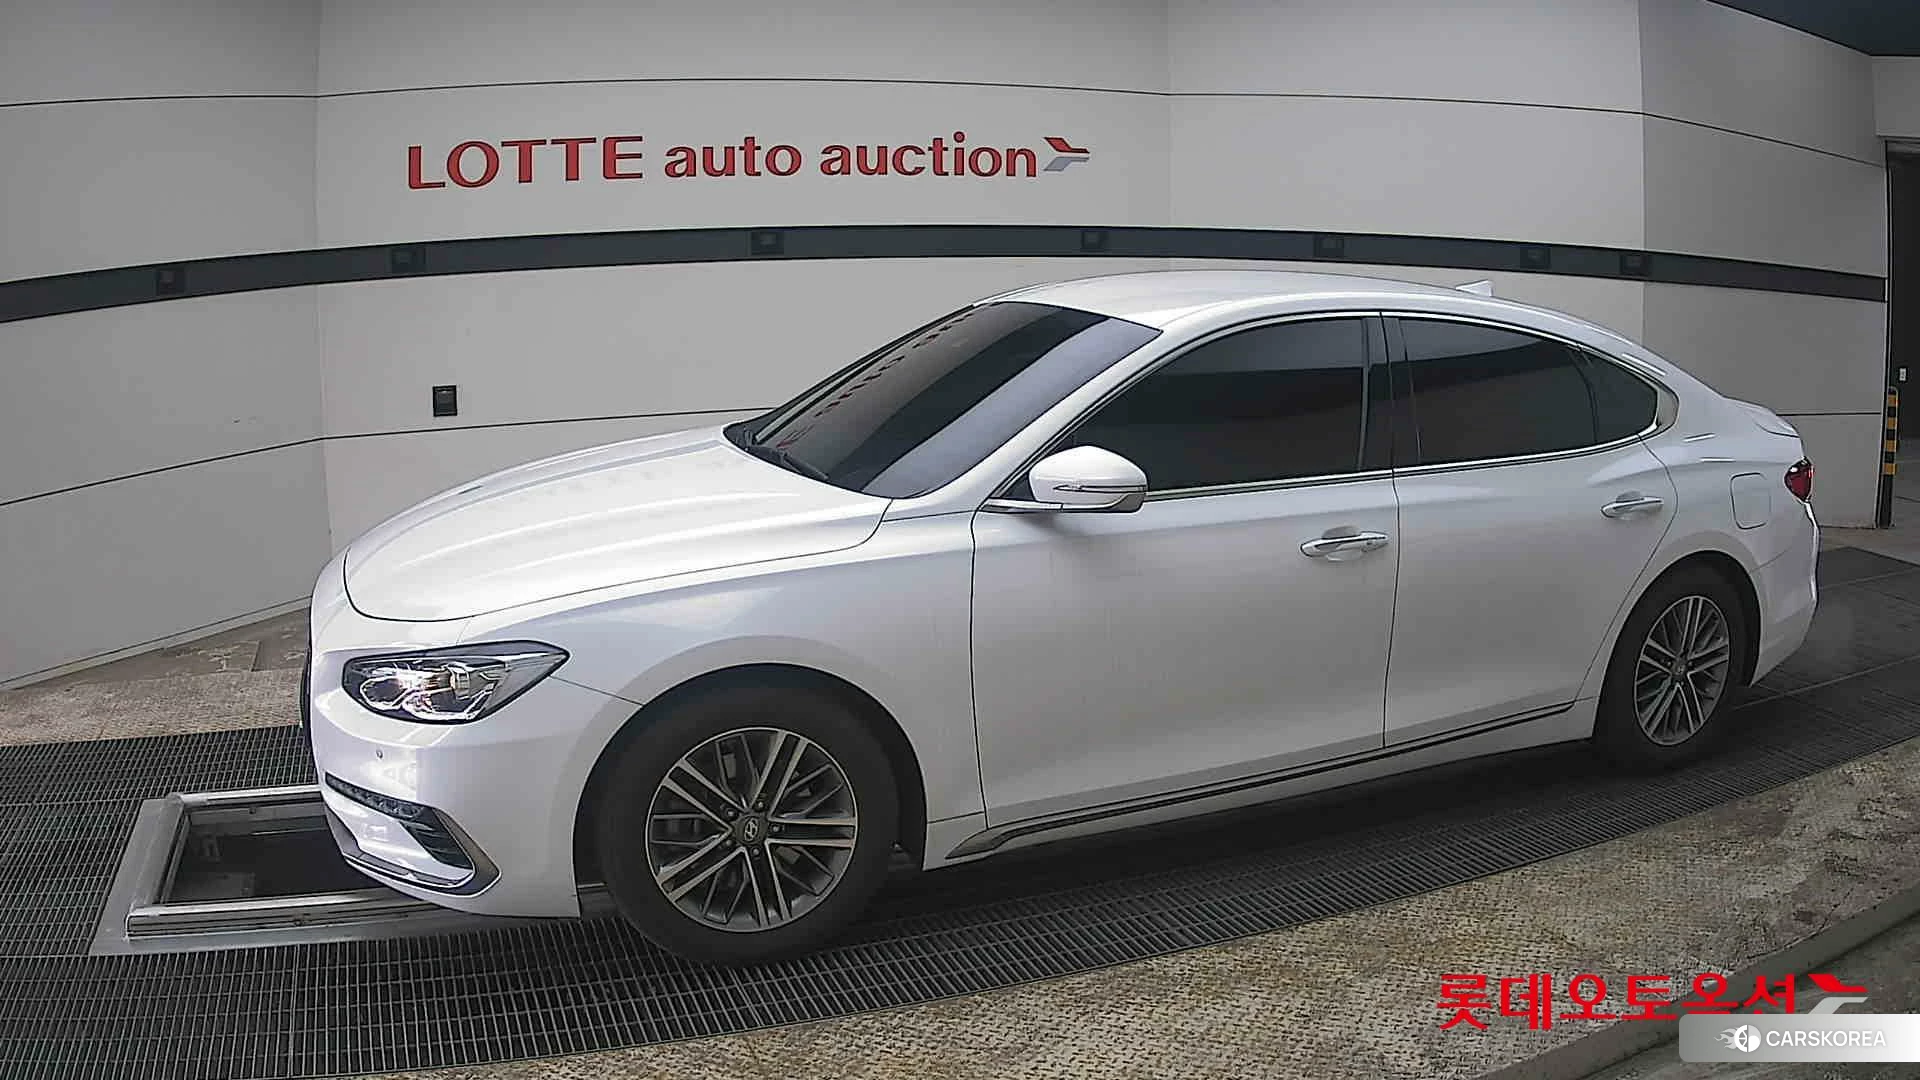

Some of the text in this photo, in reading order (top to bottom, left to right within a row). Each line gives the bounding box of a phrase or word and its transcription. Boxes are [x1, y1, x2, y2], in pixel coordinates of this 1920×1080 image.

[408, 132, 1037, 189] LOTTE auto auction
